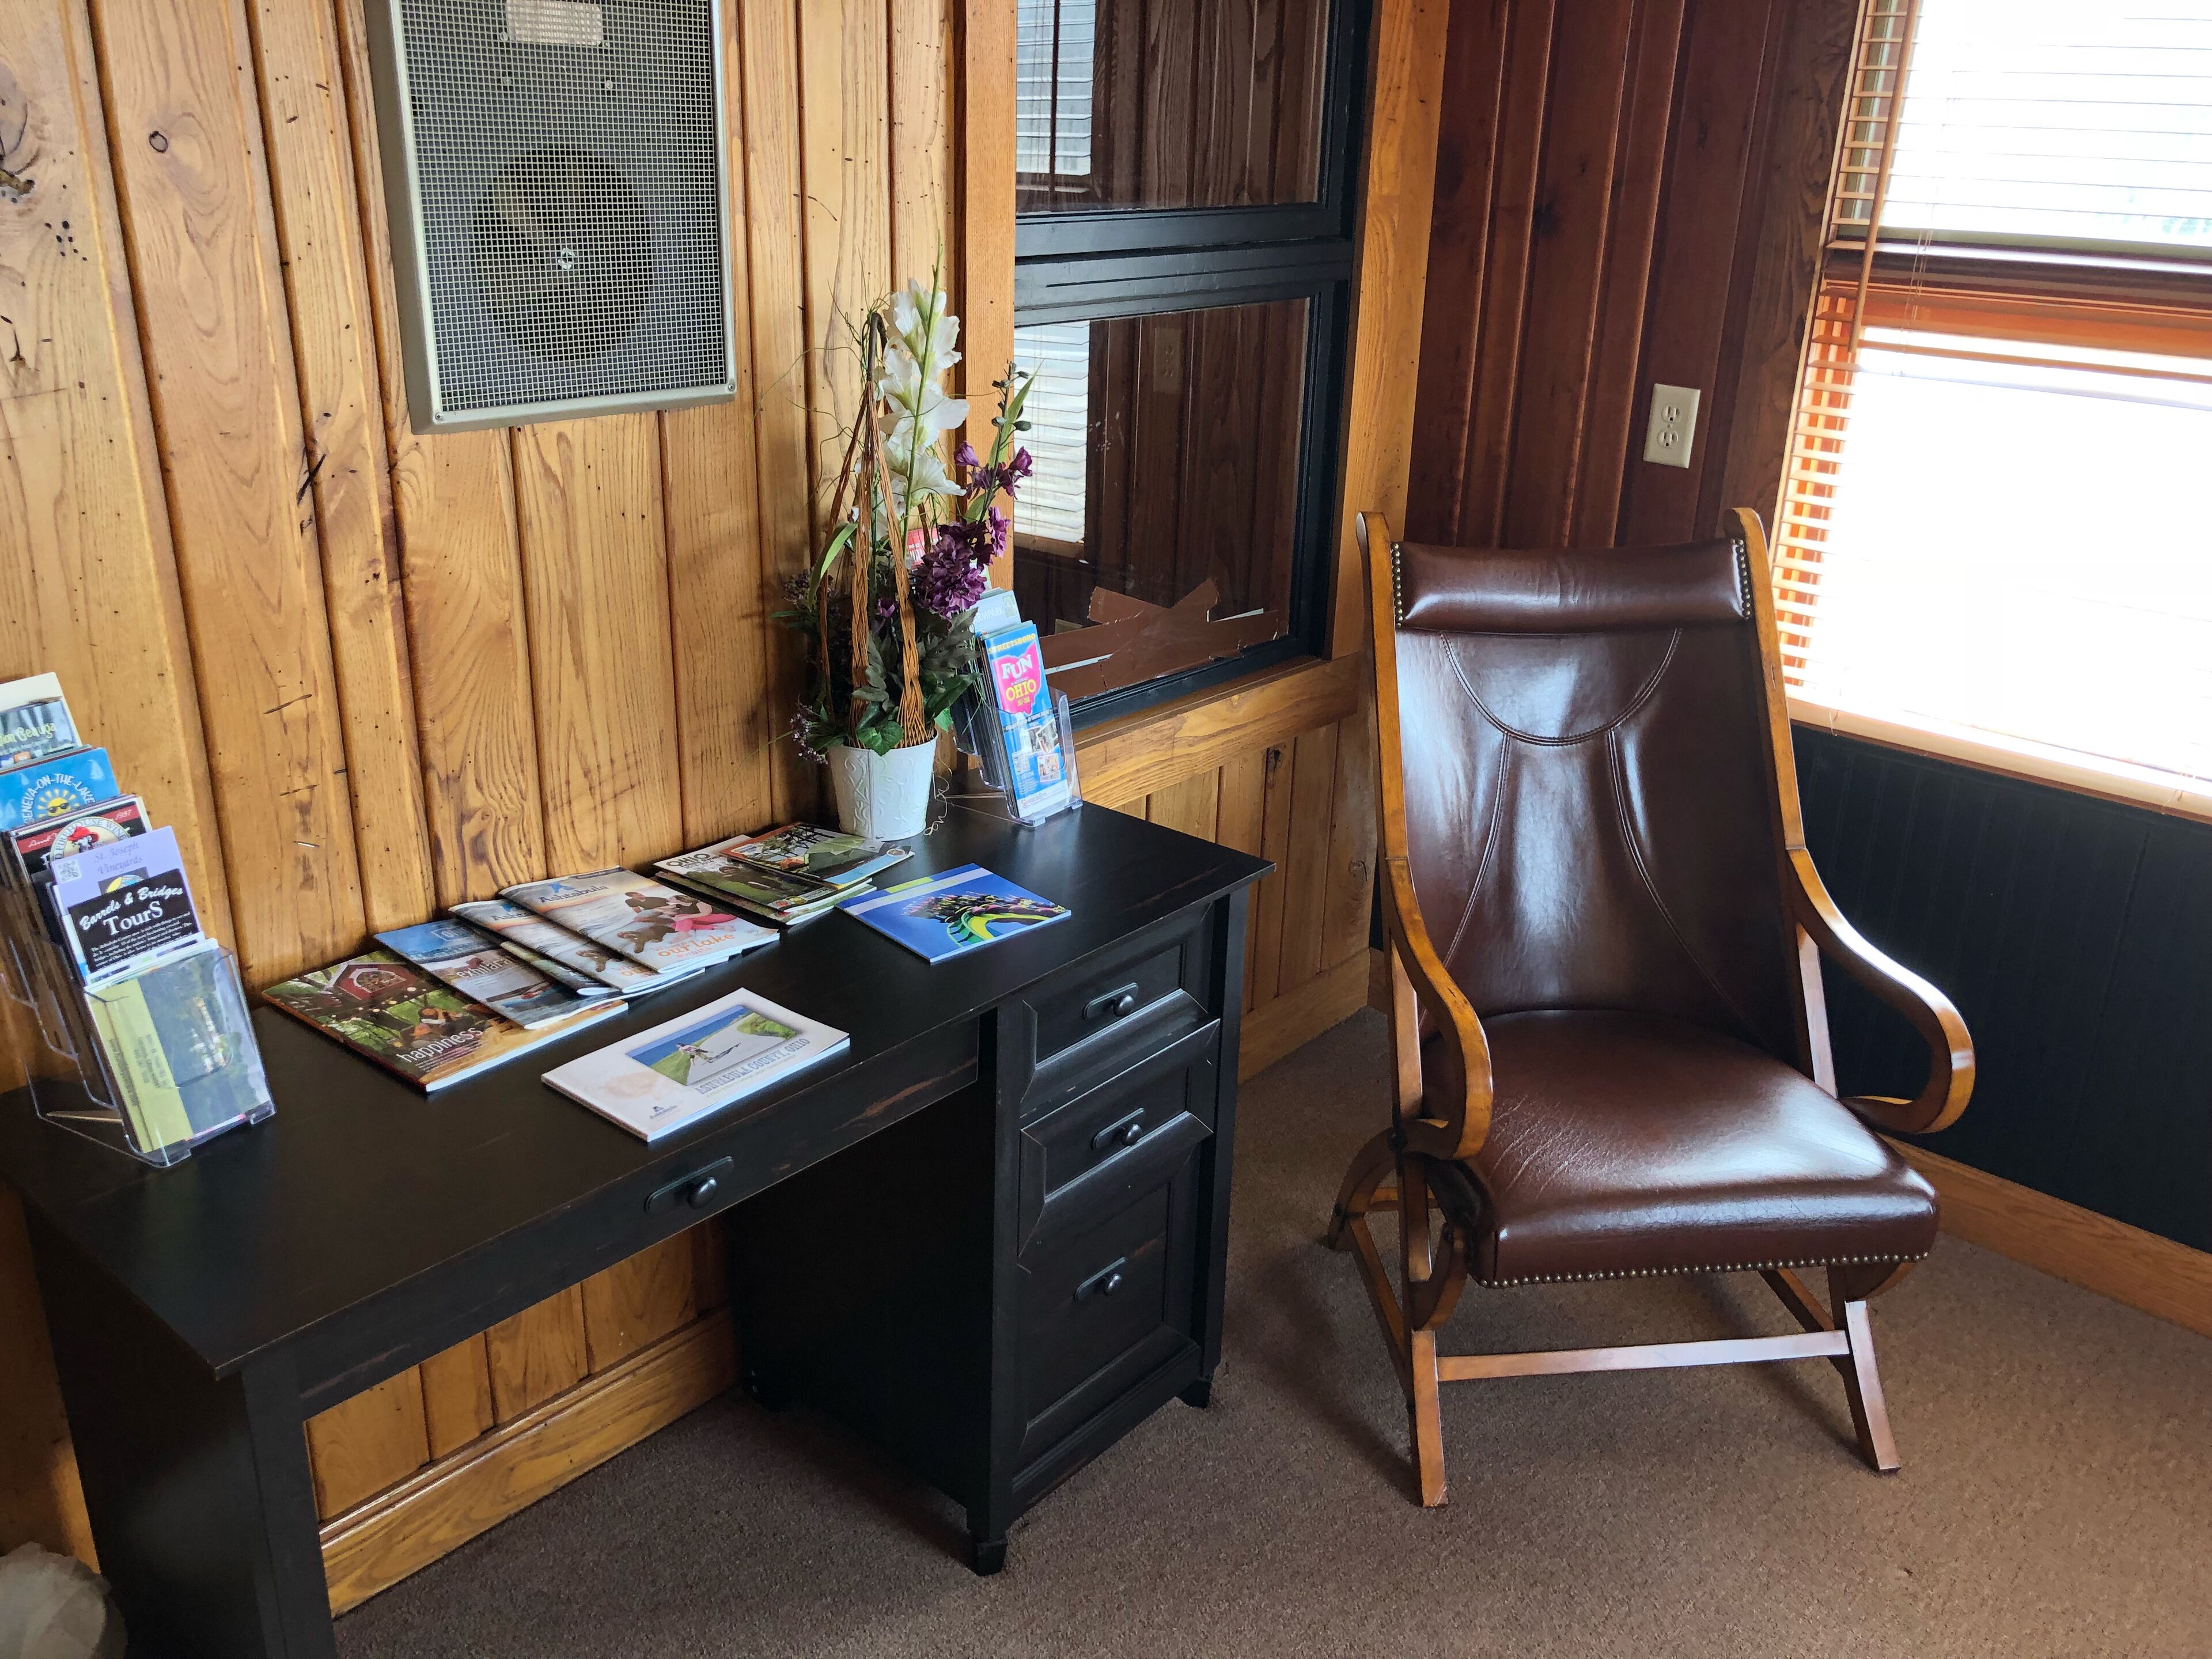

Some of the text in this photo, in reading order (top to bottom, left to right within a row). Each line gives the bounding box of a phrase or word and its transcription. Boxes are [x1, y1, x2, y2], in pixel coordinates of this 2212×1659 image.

[974, 606, 1005, 623] ARMPARK
[988, 633, 1036, 654] STREETSBORO
[1001, 654, 1033, 679] FUN
[1005, 679, 1037, 702] OHIO
[16, 722, 56, 741] Geauga
[21, 773, 96, 824] GENEVA-ON-THE-LAKE
[94, 841, 139, 863] St. Joseph
[666, 853, 711, 868] OHIO
[97, 855, 143, 874] Vineyards
[538, 885, 609, 903] Ashtabula
[79, 899, 121, 930] Barrels
[124, 892, 134, 906] &
[137, 885, 184, 900] Bridges
[103, 900, 164, 935] TourS
[658, 944, 690, 957] our
[688, 934, 736, 948] lake
[456, 957, 513, 978] exhilara
[396, 1027, 483, 1063] happiness
[695, 1064, 751, 1095] ASHTABULA
[785, 1037, 811, 1052] OHIO
